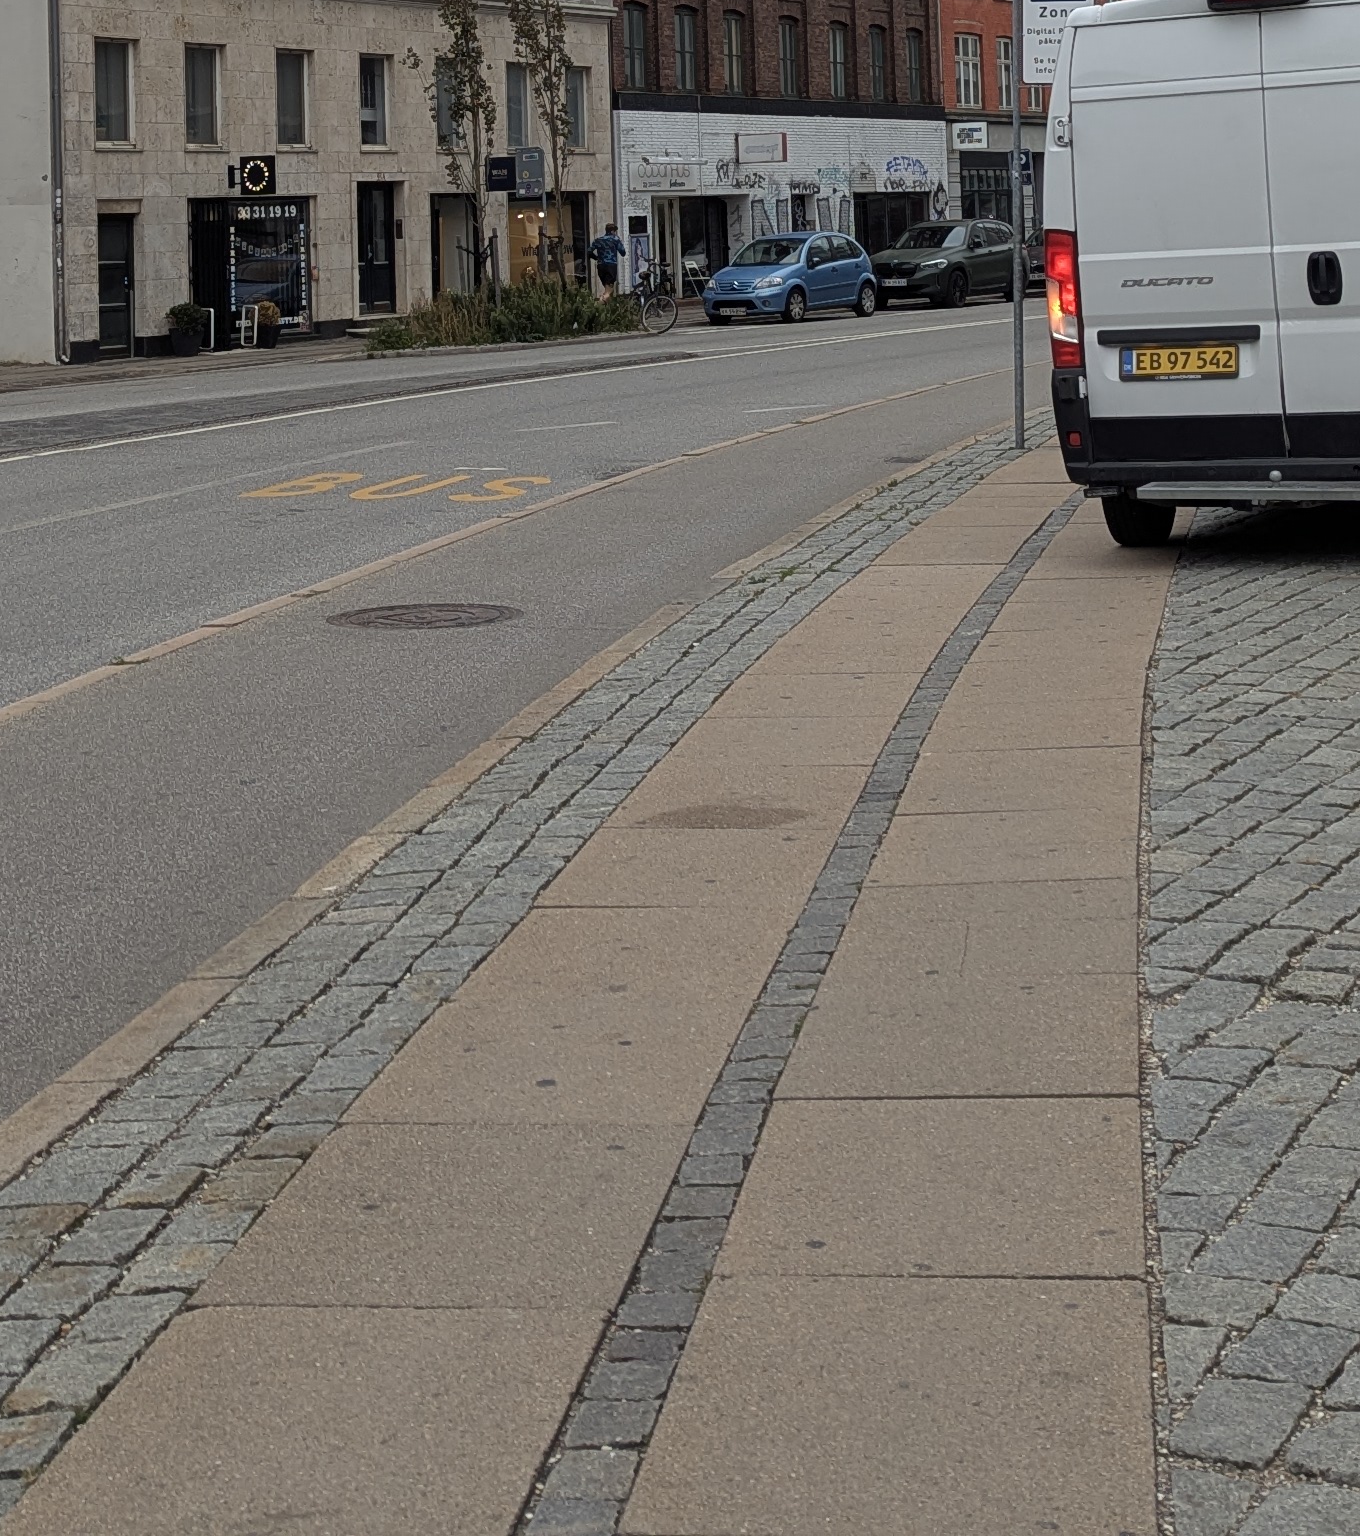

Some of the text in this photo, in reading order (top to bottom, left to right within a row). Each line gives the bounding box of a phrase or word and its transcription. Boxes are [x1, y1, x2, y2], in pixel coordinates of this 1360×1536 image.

[1027, 27, 1055, 36] Digital
[253, 205, 266, 218] 31
[269, 205, 281, 218] 19
[284, 204, 296, 217] 19
[1121, 276, 1213, 288] DUCATO
[1136, 352, 1162, 371] EB
[1167, 351, 1191, 371] 97
[1196, 350, 1233, 370] 542
[237, 471, 552, 502] BUS
